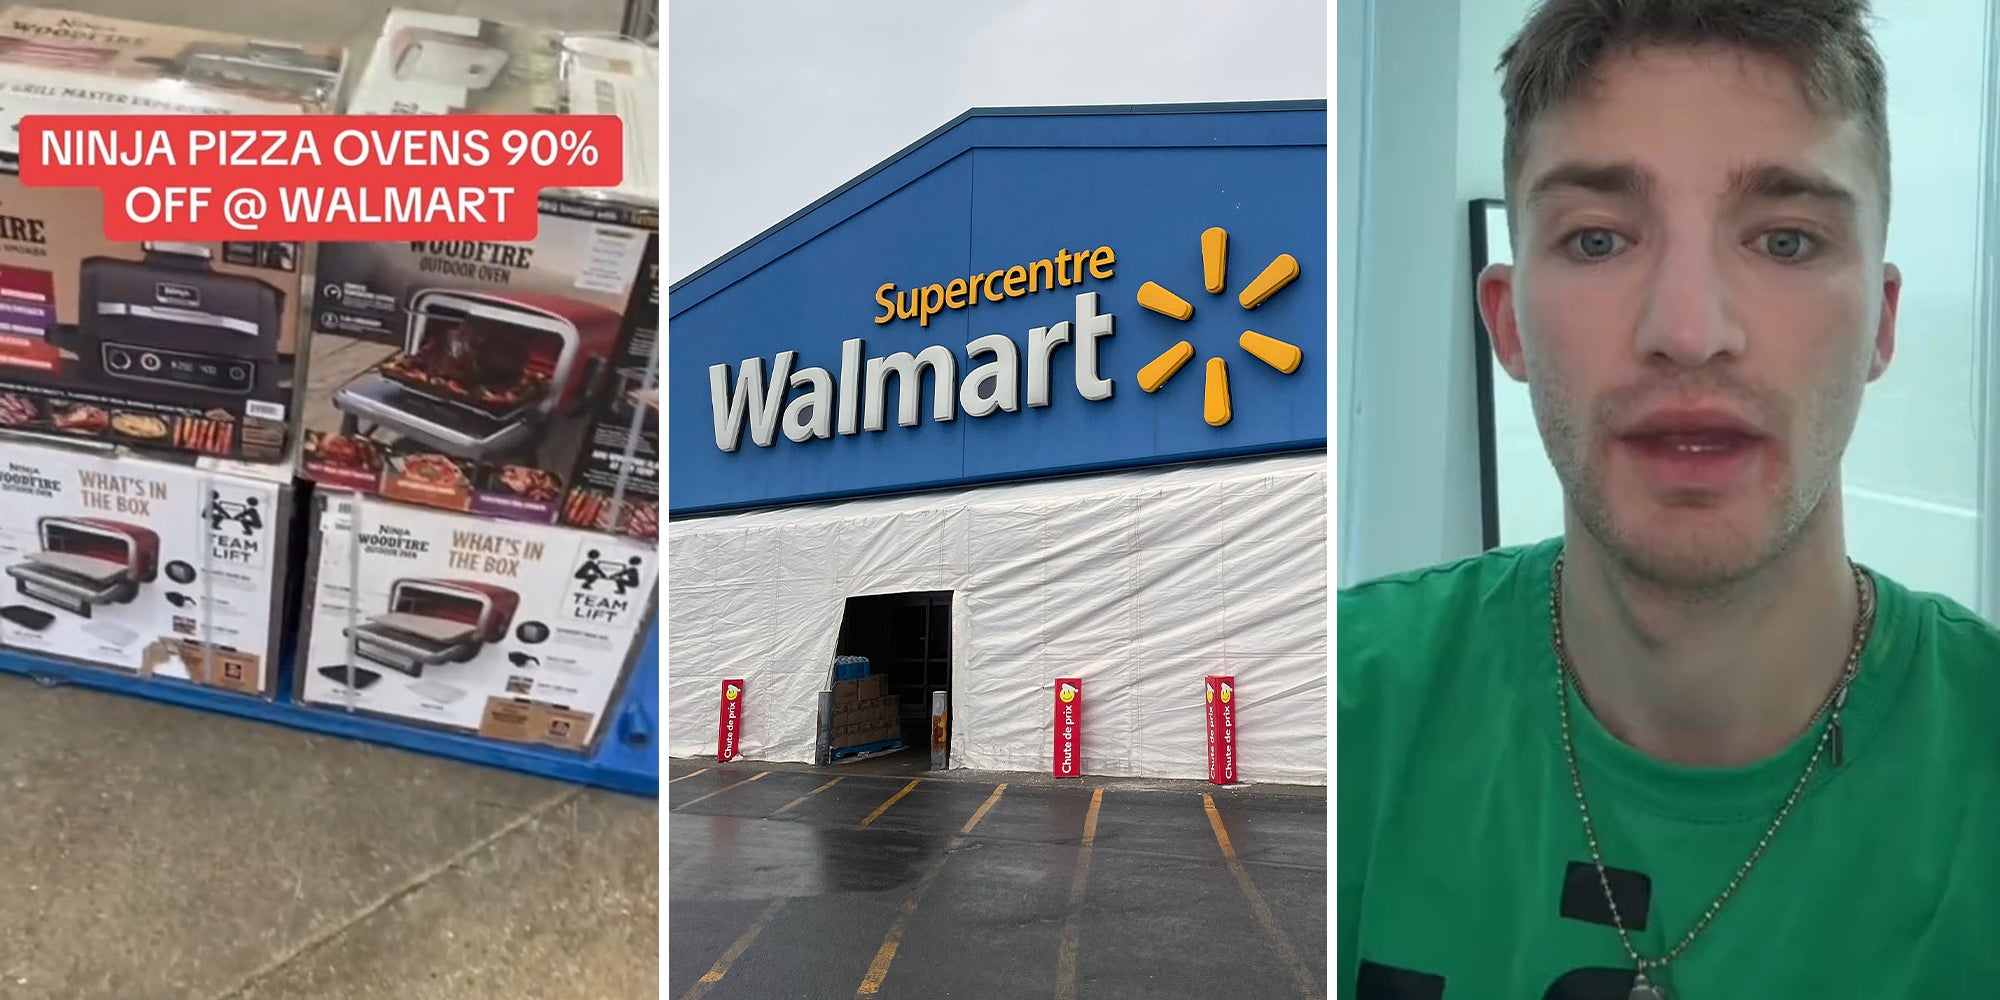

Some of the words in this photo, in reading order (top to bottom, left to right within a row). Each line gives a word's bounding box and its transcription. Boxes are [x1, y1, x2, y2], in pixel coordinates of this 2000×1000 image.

[62, 87, 128, 104] MASTER
[410, 241, 534, 269] WOODFIRE
[419, 257, 477, 278] OUTDOOR
[478, 265, 511, 284] OVEN
[874, 245, 1116, 327] Supercentre
[708, 291, 1116, 452] Walmart
[78, 469, 145, 496] WHAT'S
[149, 482, 168, 500] IN
[81, 490, 112, 510] THE
[116, 498, 150, 516] BOX
[213, 547, 251, 562] LIFT
[358, 534, 430, 552] WOODFIRE
[452, 530, 520, 556] WHAT'S
[523, 541, 545, 561] IN
[448, 550, 480, 570] THE
[484, 556, 520, 577] BOX
[574, 592, 628, 611] TEAM
[575, 606, 617, 622] LIFT
[726, 720, 734, 731] de
[1063, 705, 1074, 725] prix
[1223, 706, 1232, 727] prix
[724, 732, 733, 758] Chute
[1063, 727, 1072, 740] de
[1224, 729, 1231, 742] de
[1062, 742, 1072, 774] Chute
[1225, 745, 1233, 779] Chute
